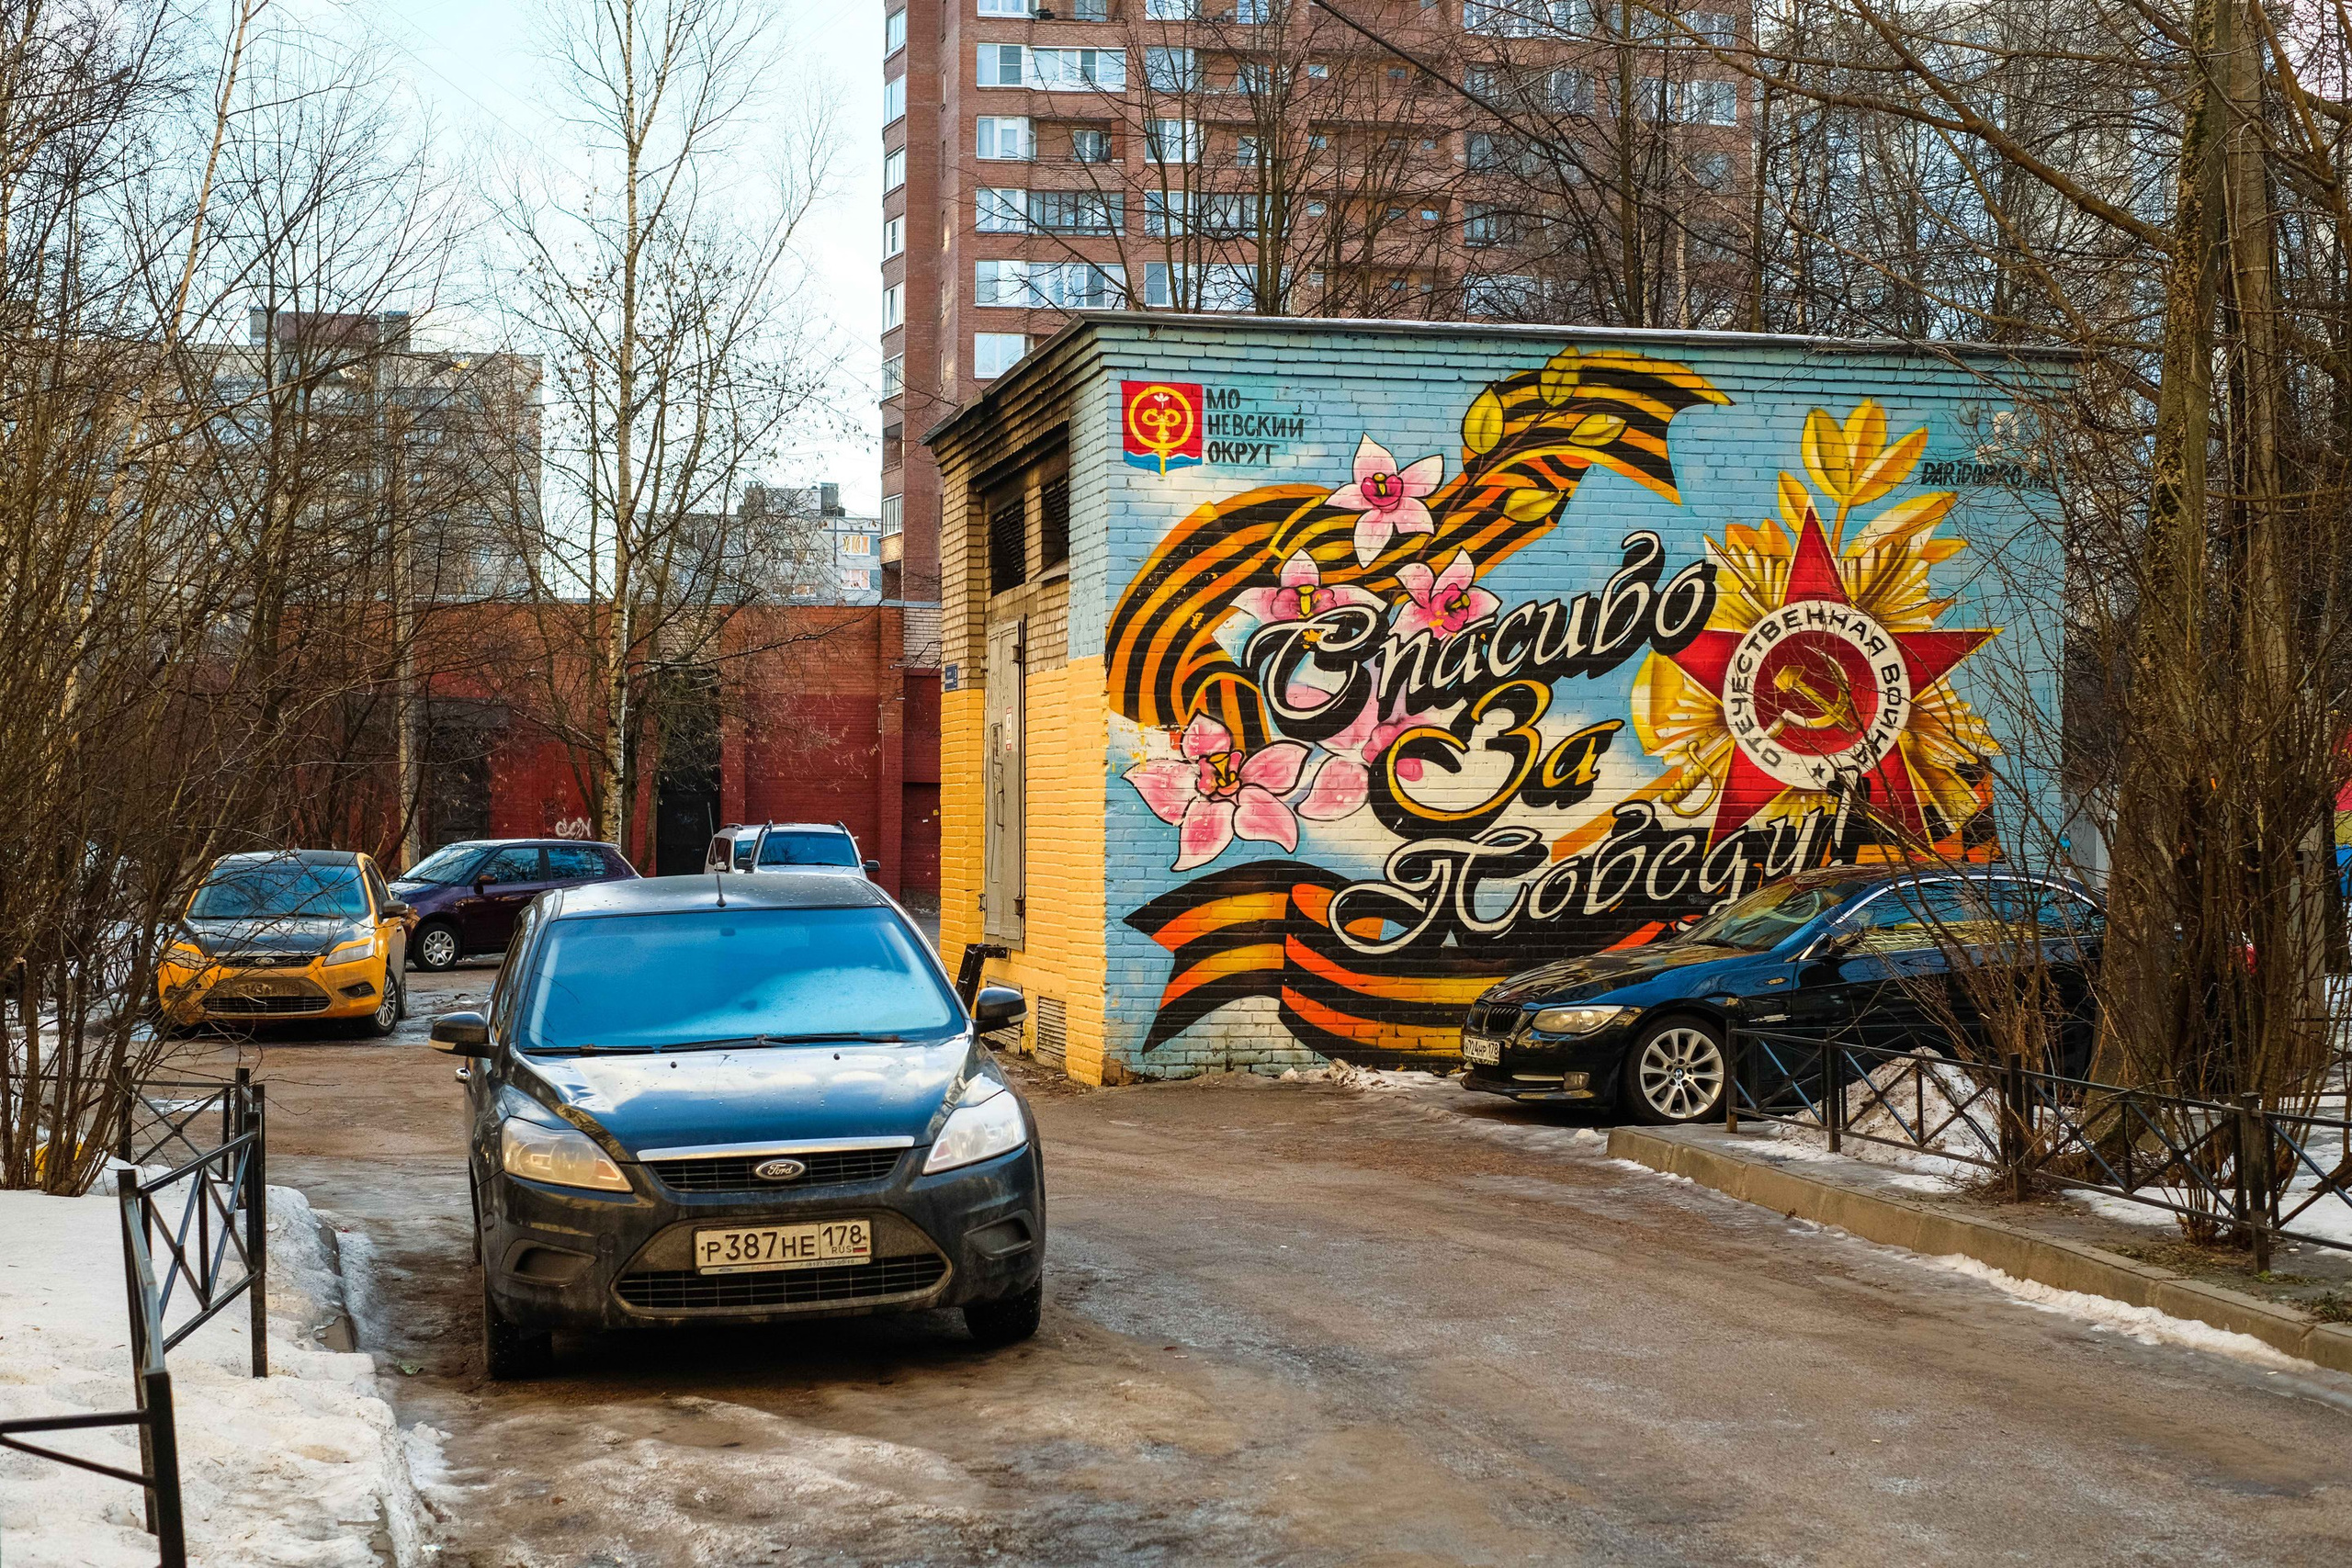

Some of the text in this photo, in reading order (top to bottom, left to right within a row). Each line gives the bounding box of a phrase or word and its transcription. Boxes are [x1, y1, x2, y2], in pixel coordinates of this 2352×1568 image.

[1206, 388, 1241, 410] МО
[1207, 441, 1280, 464] ОКРУГ
[1247, 530, 1714, 721] Спасибо
[1730, 608, 1888, 768] ОТЕЧЕСТВЕННАЯ
[1386, 681, 1624, 821] За
[1328, 767, 1860, 953] Победу!
[1487, 1042, 1498, 1055] 178
[767, 1162, 794, 1176] Ford
[707, 1224, 862, 1262] Р387НЕ 178
[831, 1245, 853, 1255] RUS
